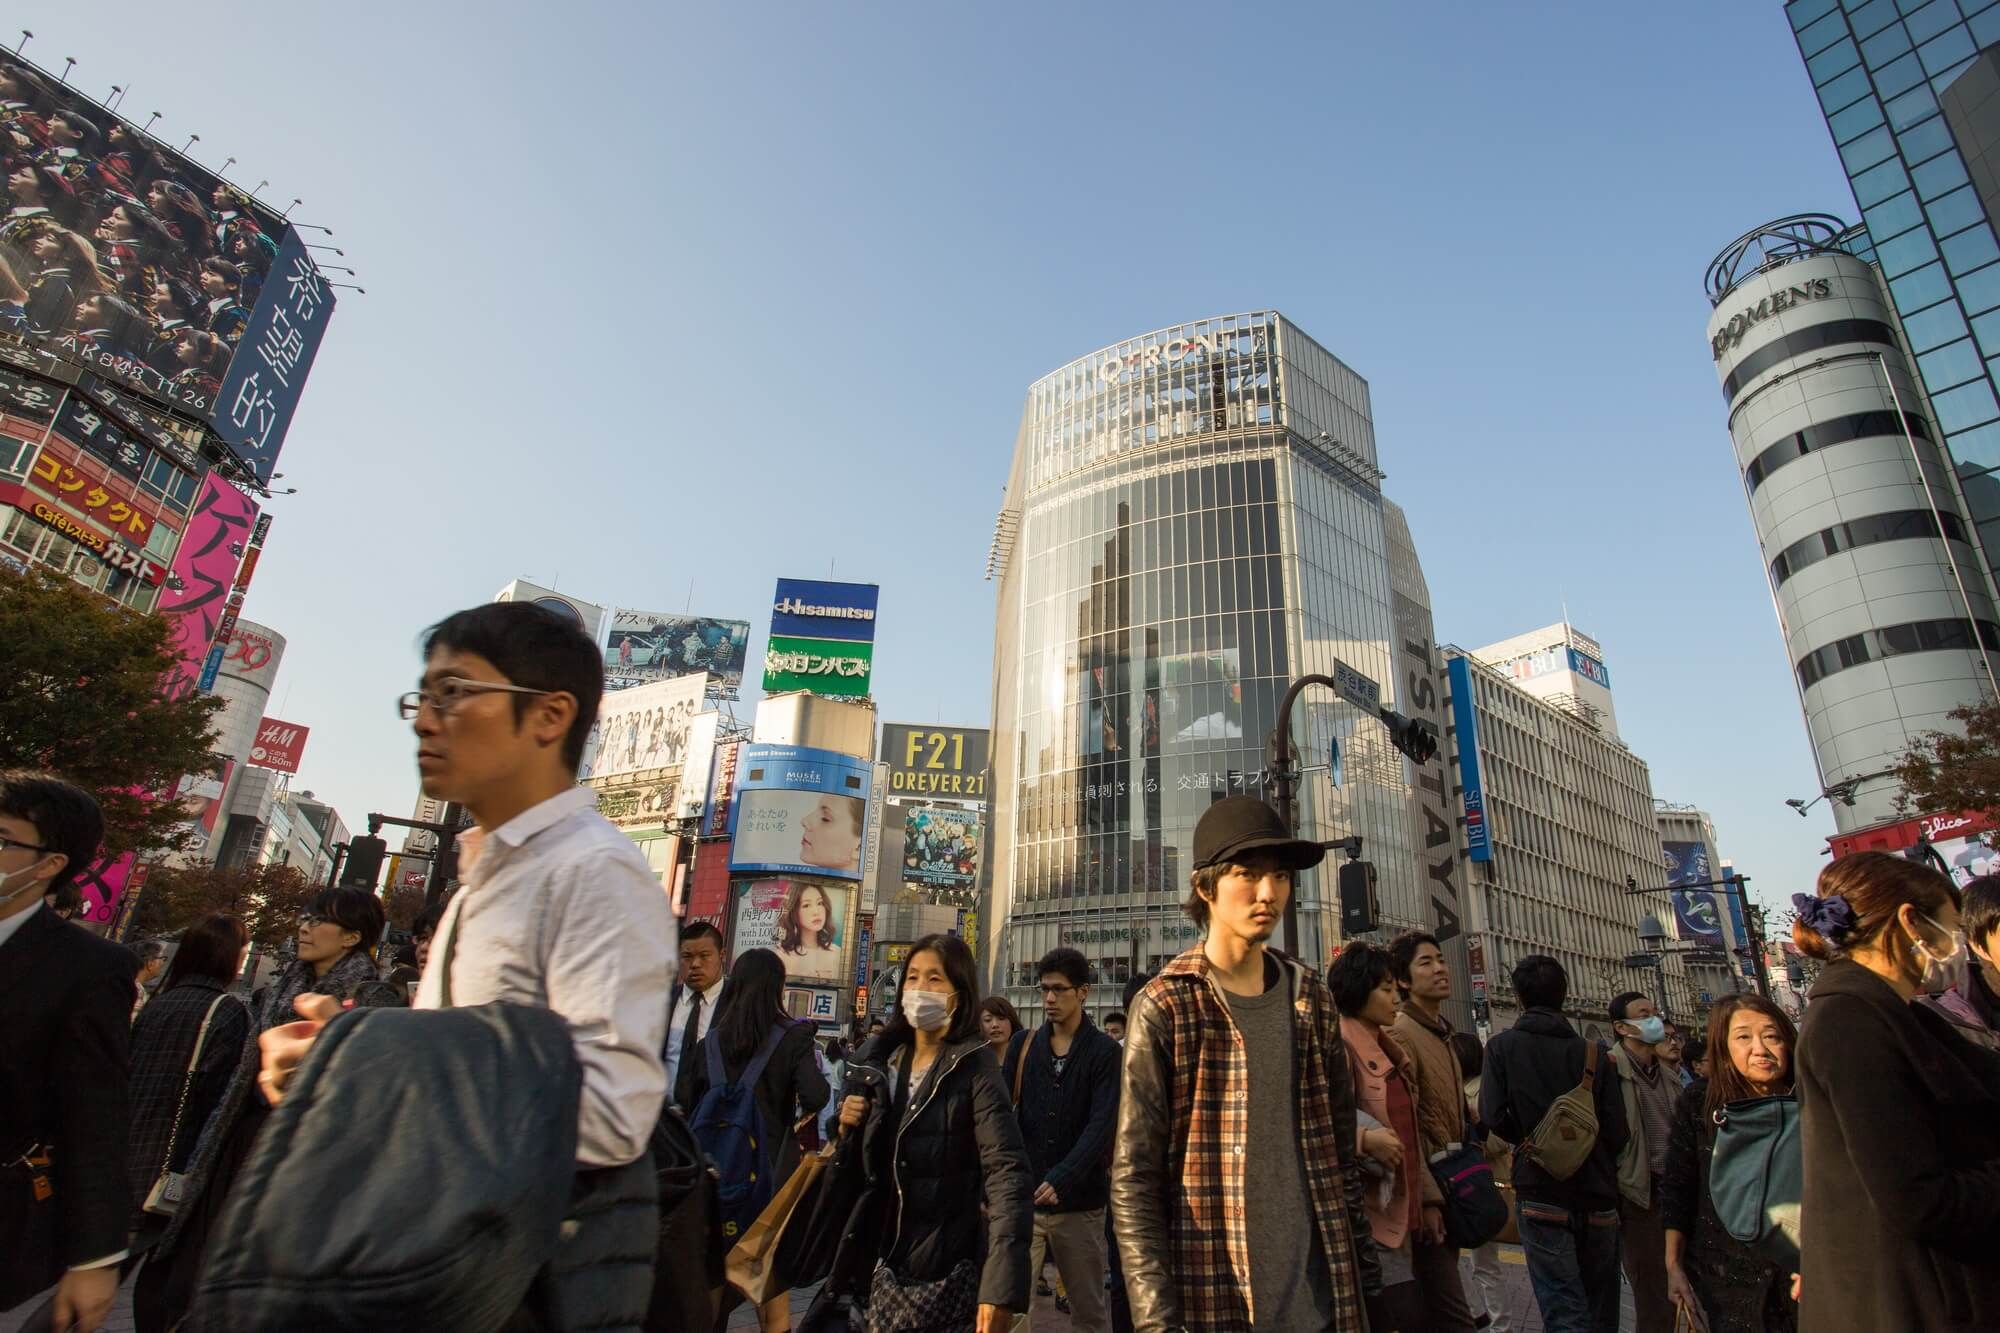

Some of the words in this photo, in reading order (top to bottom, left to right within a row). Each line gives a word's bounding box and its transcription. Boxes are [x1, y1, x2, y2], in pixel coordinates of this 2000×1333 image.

[61, 337, 144, 381] AKB48
[33, 453, 147, 534] コンタクト
[103, 541, 155, 579] ガスト
[774, 596, 874, 621] Hisamitsu
[905, 731, 964, 771] F21
[965, 776, 984, 794] 21
[1463, 789, 1486, 848] SEIBU
[1921, 816, 1972, 840] Glico
[1063, 926, 1152, 944] STARBUCKS
